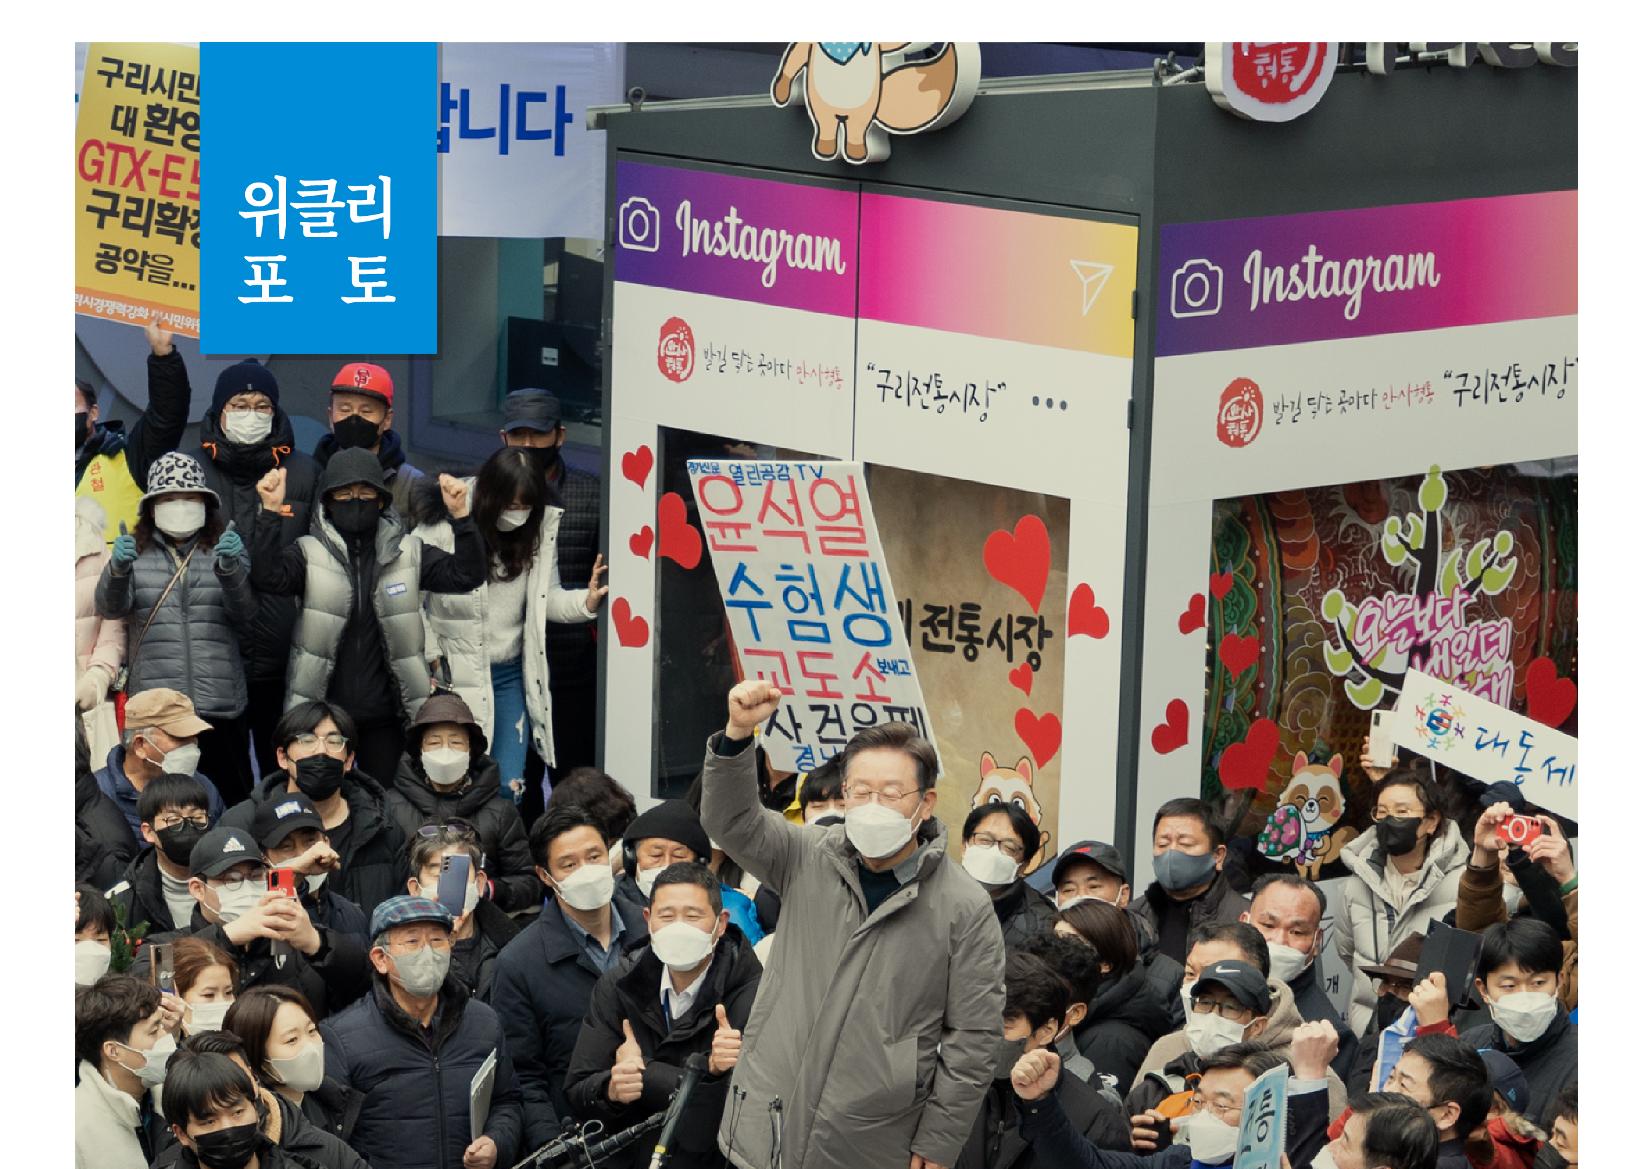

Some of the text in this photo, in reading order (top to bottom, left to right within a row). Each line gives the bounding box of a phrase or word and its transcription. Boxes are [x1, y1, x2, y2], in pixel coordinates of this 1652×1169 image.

[110, 104, 139, 138] 대
[675, 200, 846, 288] Instagram
[1243, 244, 1441, 320] Instagram
[1443, 356, 1578, 407] “구리전통시장
[728, 463, 791, 486] 열린공감
[793, 463, 824, 480] TV
[698, 474, 870, 557] 윤석열
[725, 562, 892, 647] 수험생
[919, 602, 1054, 672] 전통시장
[744, 648, 892, 704] 교도소
